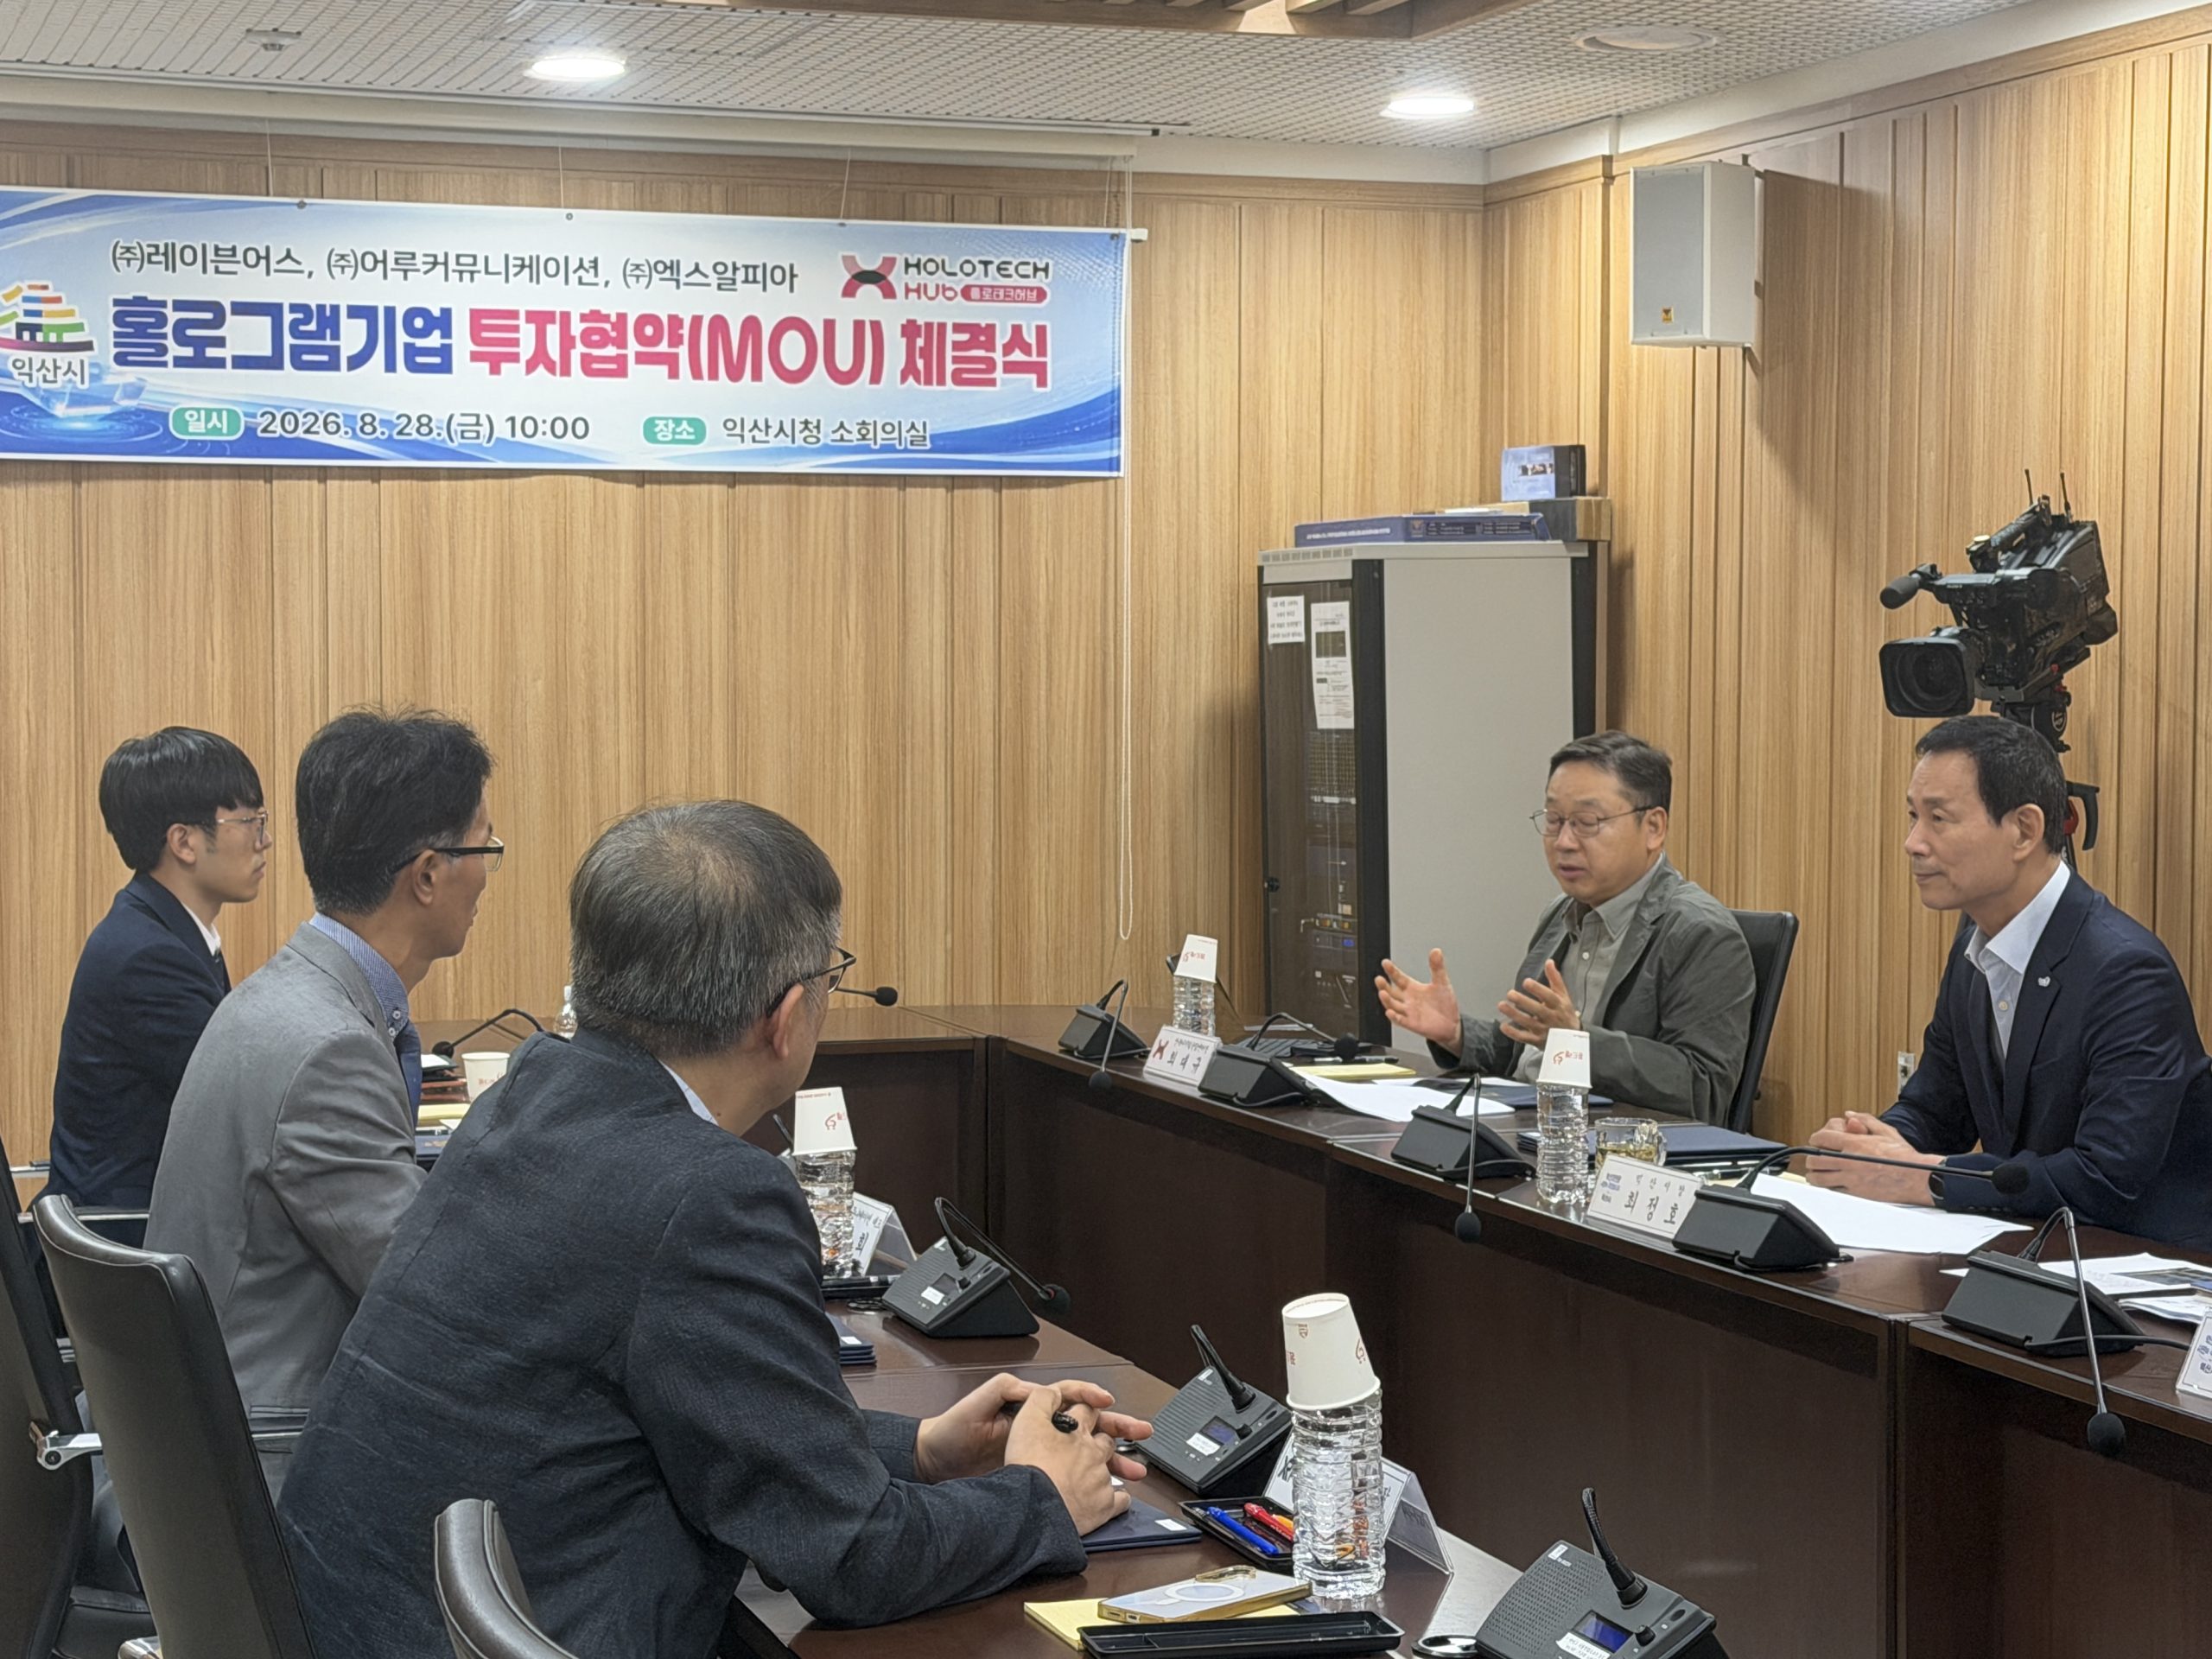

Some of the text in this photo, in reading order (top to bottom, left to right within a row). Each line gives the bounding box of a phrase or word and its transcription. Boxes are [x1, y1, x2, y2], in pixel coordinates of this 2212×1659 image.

[904, 257, 1050, 280] HOLOTECH
[112, 296, 1048, 389] 홀로그램기업 투자협약(MOU) 체결식
[11, 356, 85, 385] 익산시
[183, 410, 228, 434] 일시
[505, 415, 590, 441] 10:00
[653, 417, 696, 440] 장소
[722, 418, 930, 448] 익산시청 소회의실
